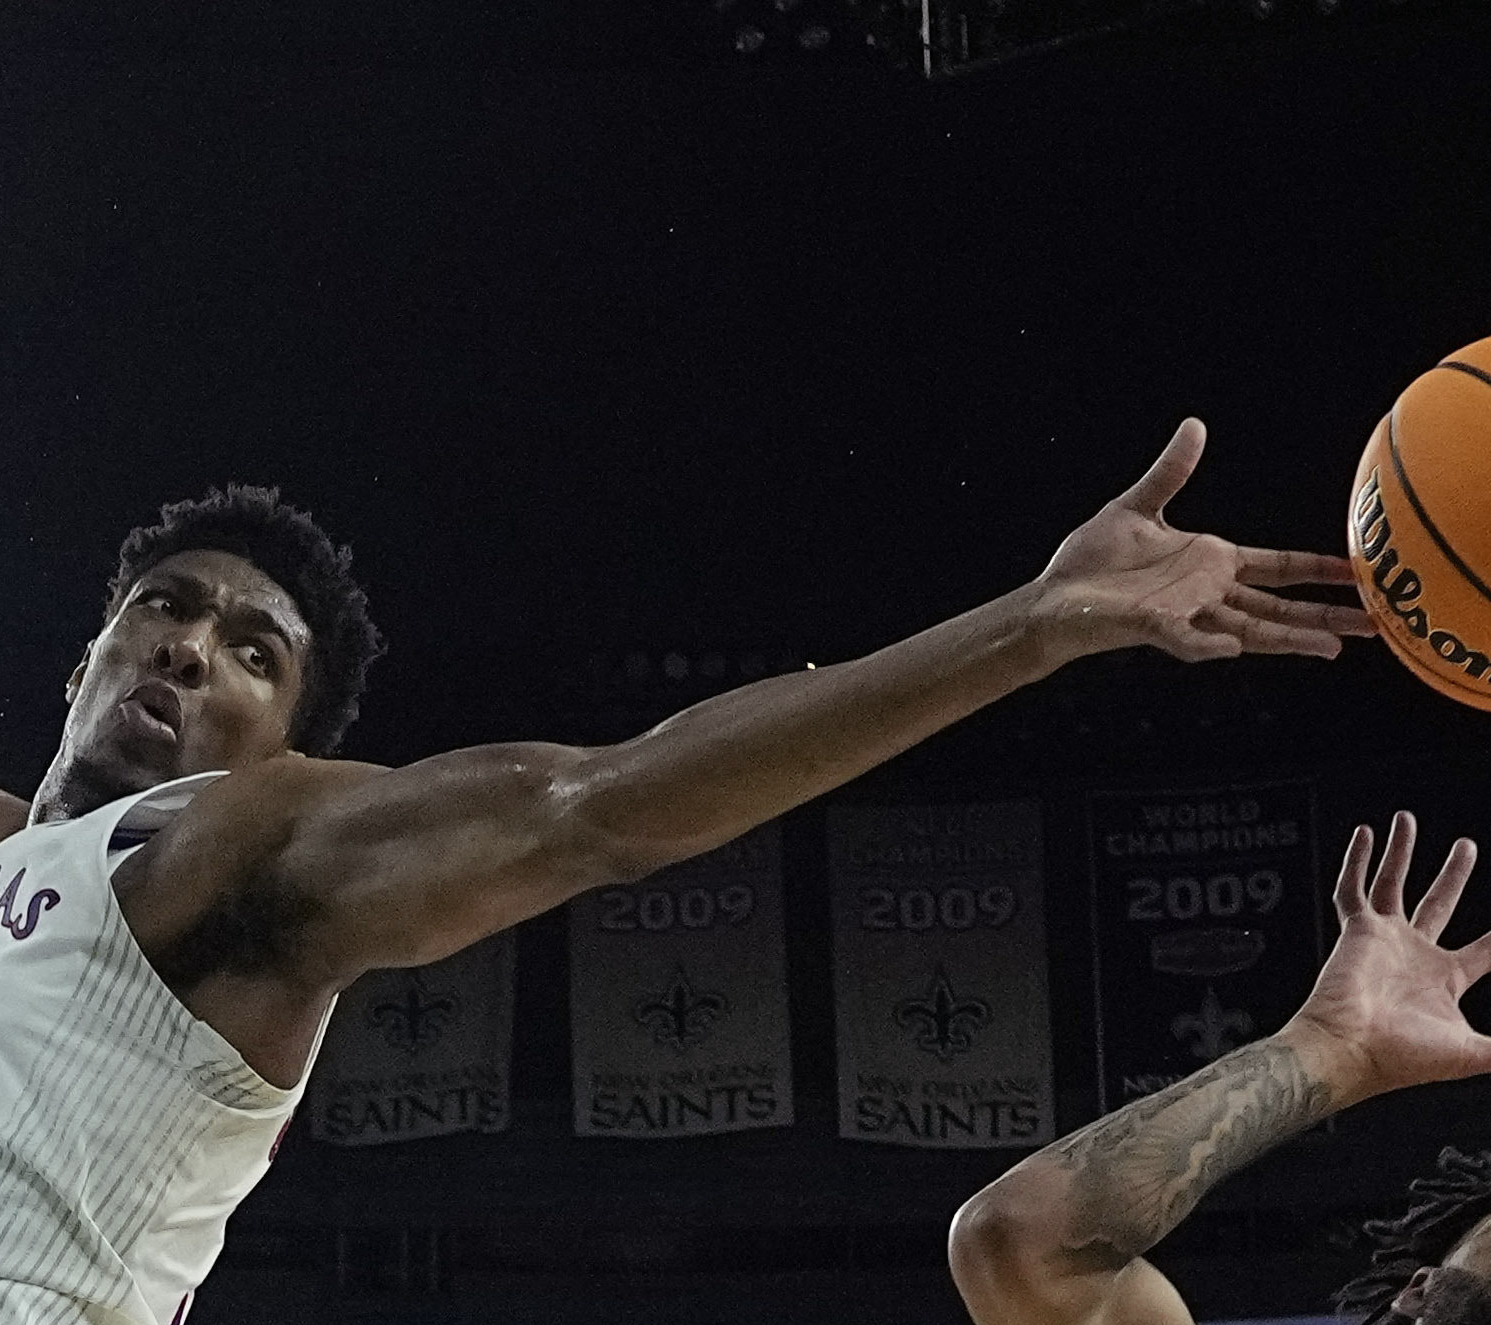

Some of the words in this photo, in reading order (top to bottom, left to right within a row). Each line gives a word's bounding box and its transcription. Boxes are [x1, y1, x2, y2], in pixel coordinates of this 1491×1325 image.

[1106, 823, 1300, 858] CHAMPIONS
[599, 884, 755, 931] 2009
[862, 886, 1013, 931] 2009
[1127, 871, 1283, 921] 2009
[325, 1089, 505, 1137] SAINTS
[590, 1084, 775, 1130] SAINTS
[855, 1099, 1040, 1138] SAINTS
